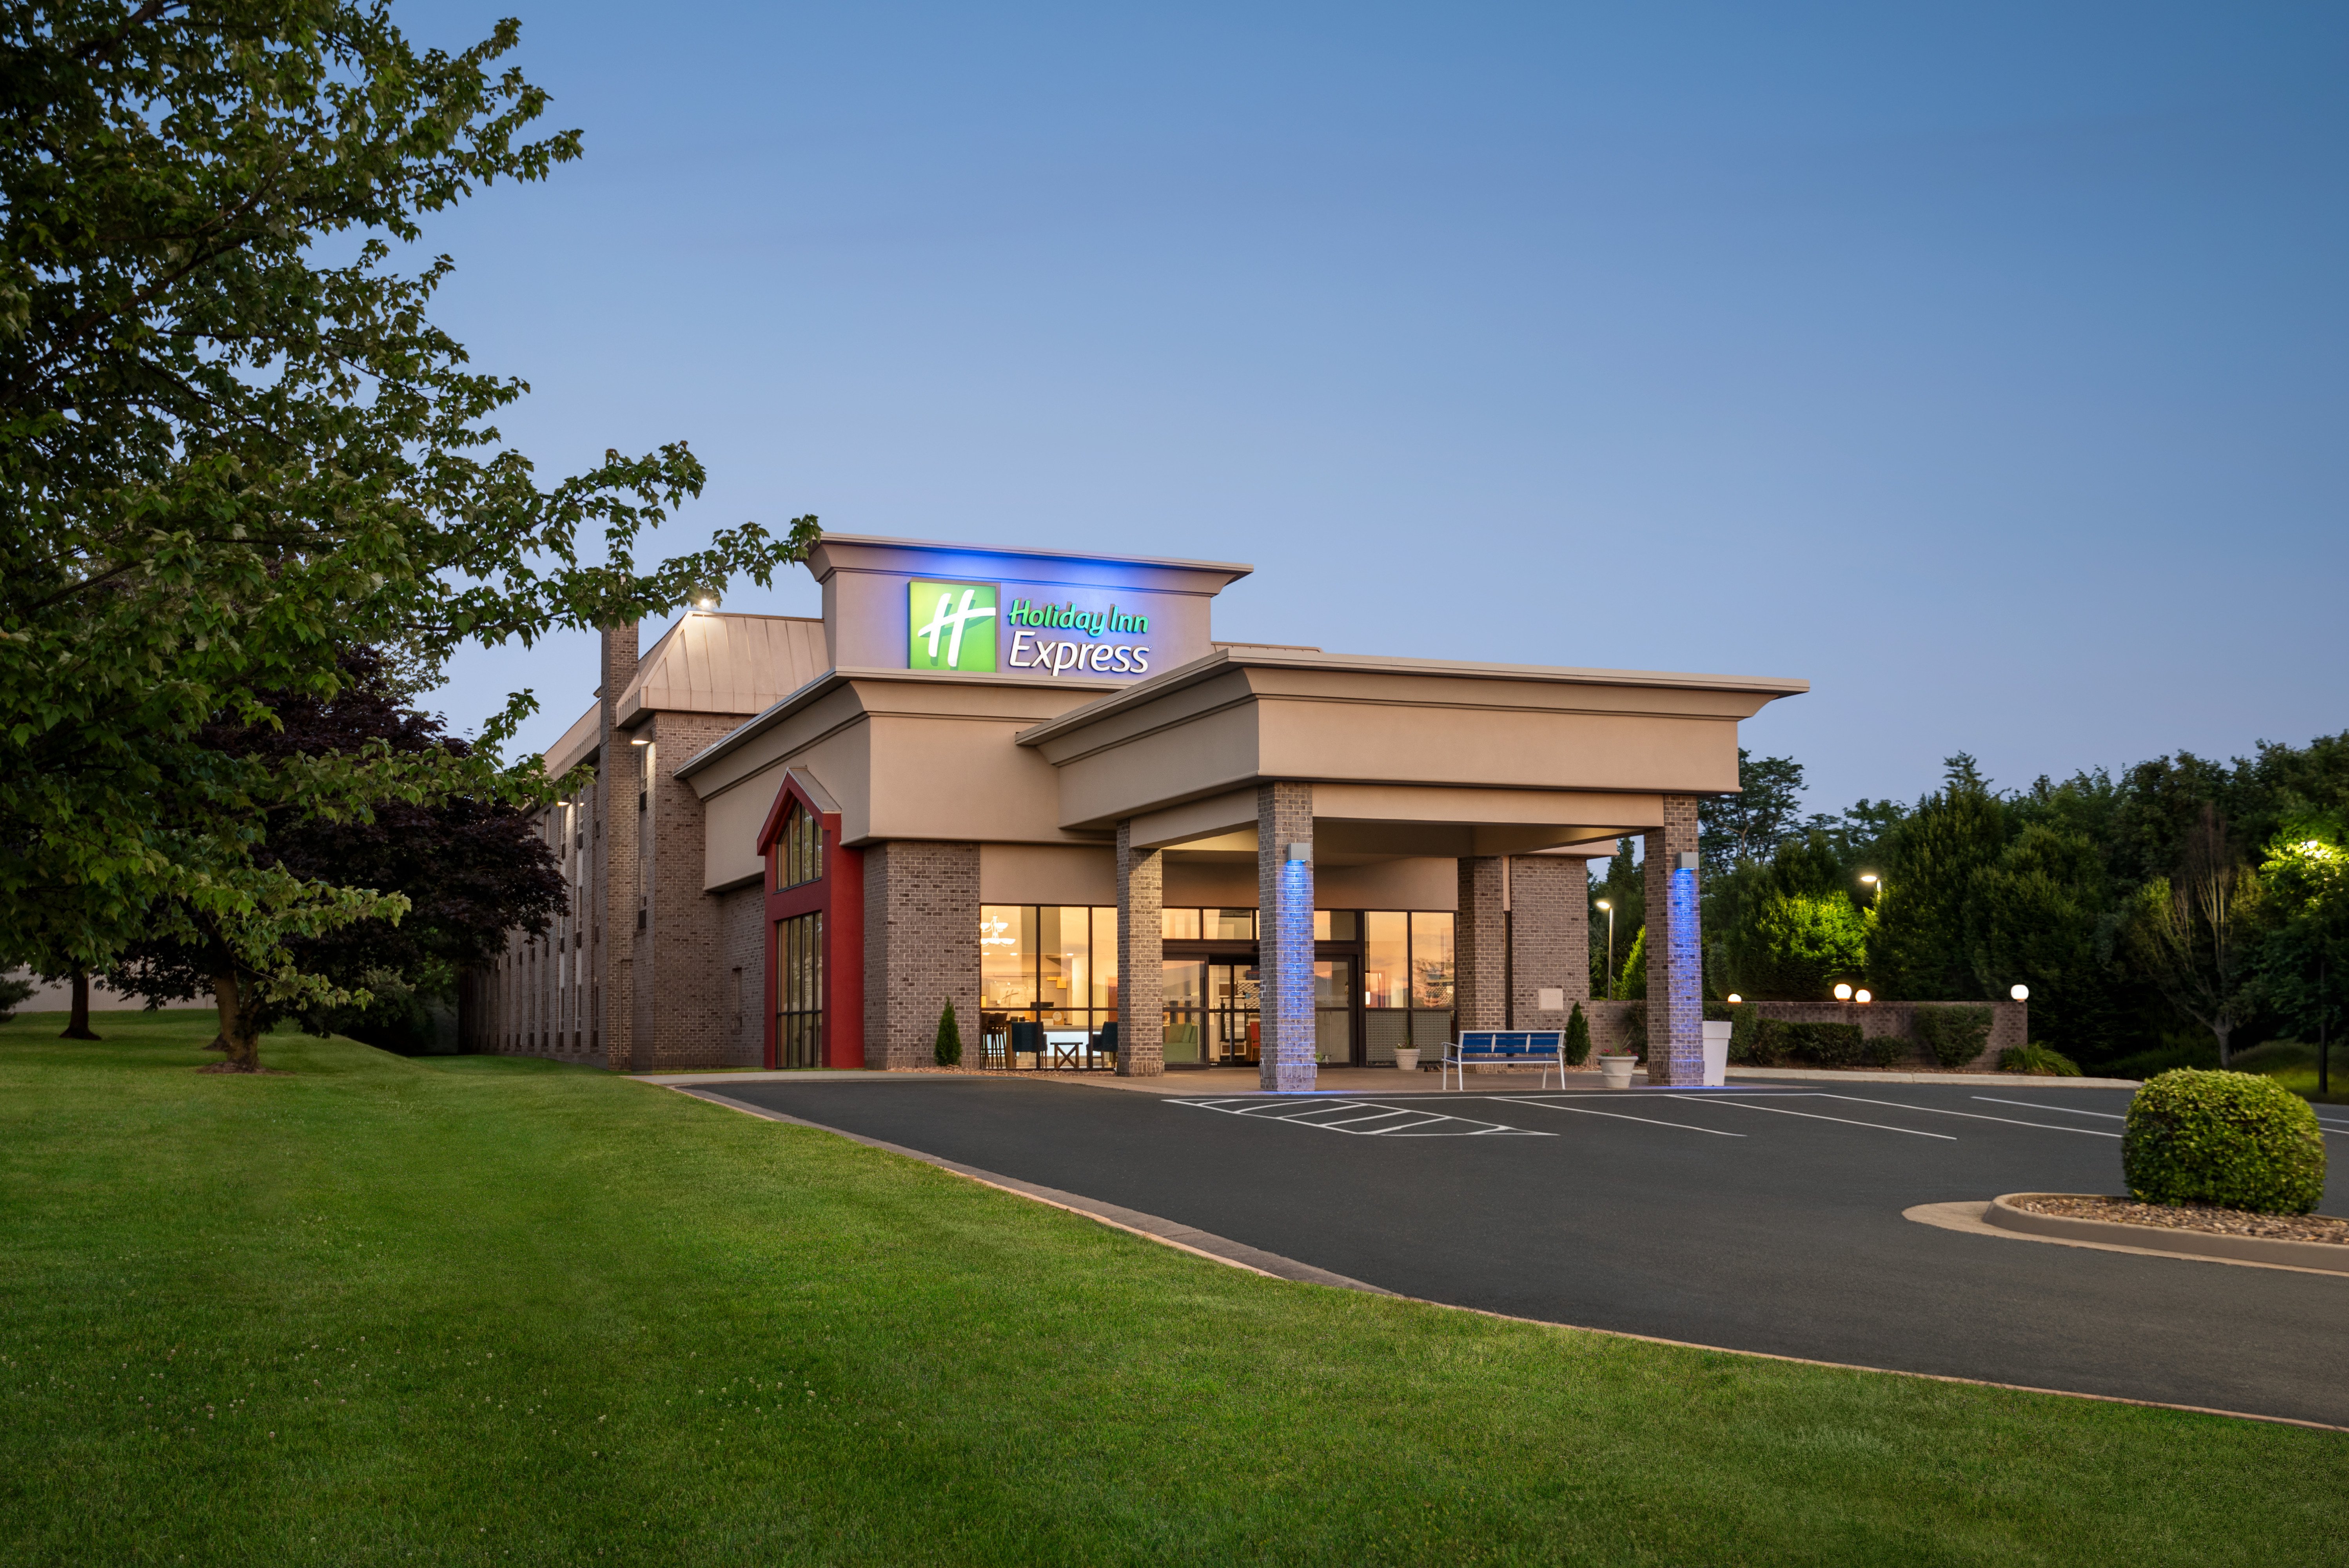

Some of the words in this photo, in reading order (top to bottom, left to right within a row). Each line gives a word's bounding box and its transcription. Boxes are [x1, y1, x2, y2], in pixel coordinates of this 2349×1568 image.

[1008, 599, 1107, 637] Holiday
[1111, 605, 1149, 633] Inn
[1009, 630, 1150, 677] Express
